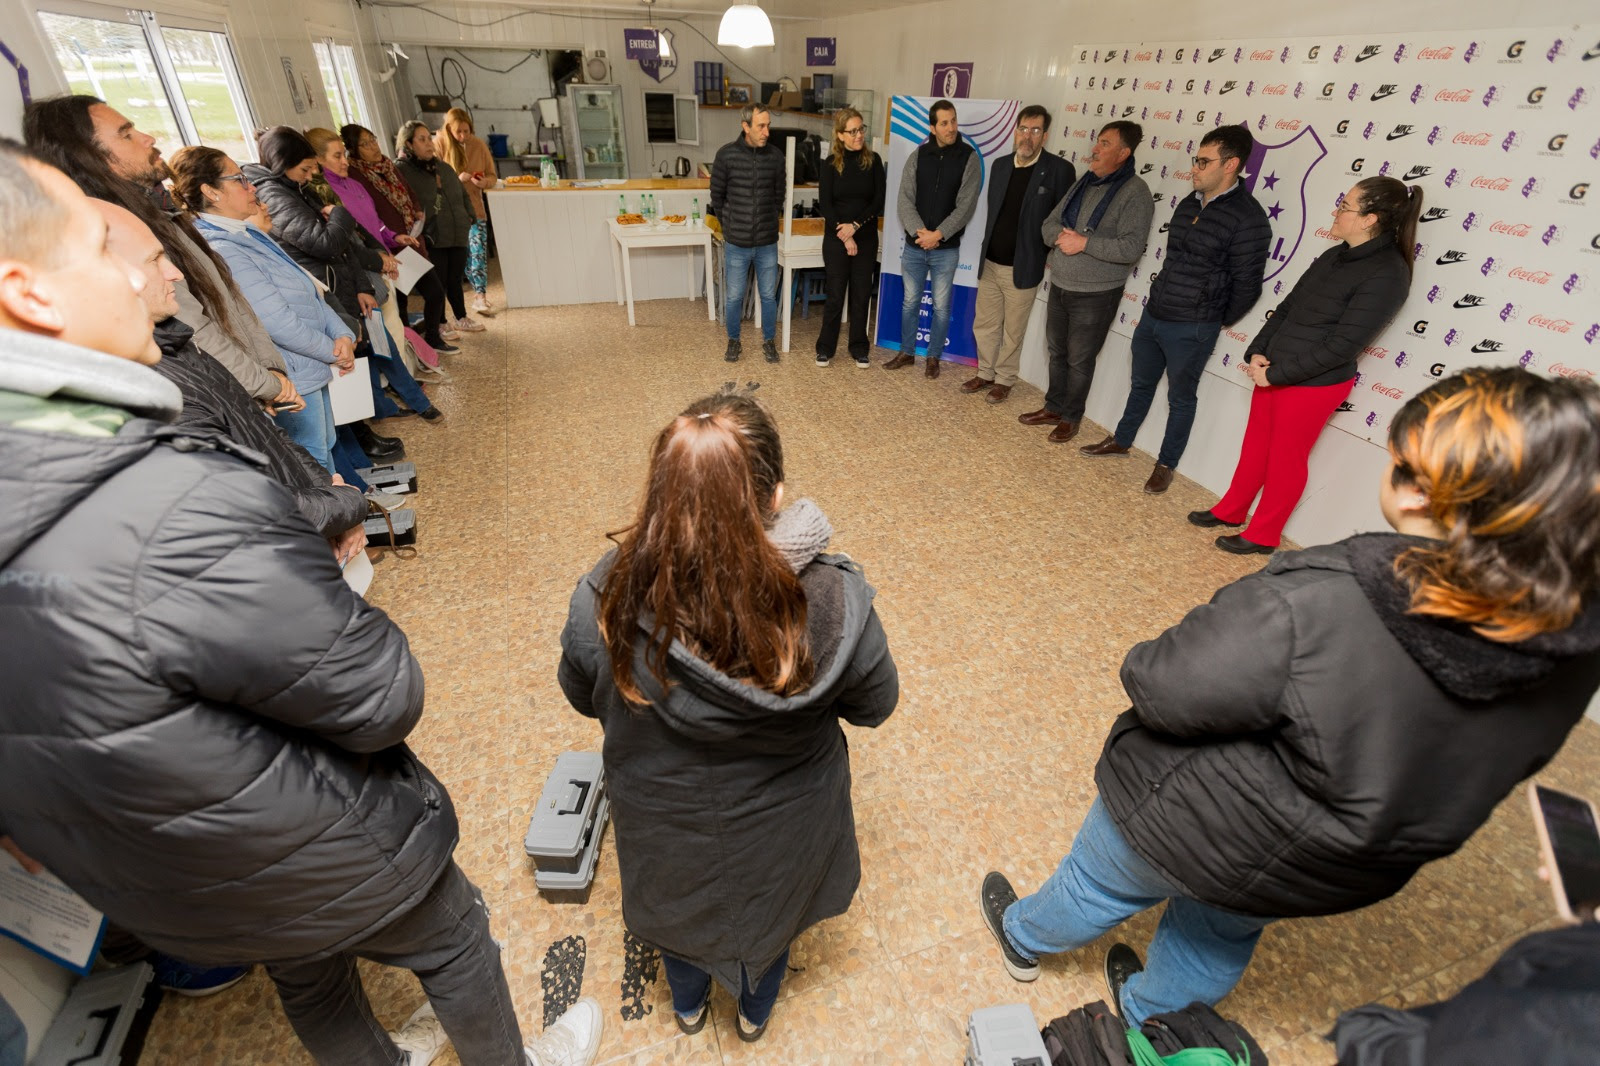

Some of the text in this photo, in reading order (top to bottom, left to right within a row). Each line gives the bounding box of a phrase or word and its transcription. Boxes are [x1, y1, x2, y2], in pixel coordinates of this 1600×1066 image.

[629, 39, 657, 49] ENTREGA
[1361, 45, 1382, 55] NIKE
[1507, 40, 1526, 59] G
[813, 46, 829, 57] CAJA
[1308, 45, 1321, 60] G
[1322, 82, 1335, 97] G
[1377, 84, 1398, 94] NIKE
[1527, 86, 1548, 105] G
[1196, 110, 1206, 123] G
[1336, 119, 1351, 134] G
[1393, 124, 1415, 134] NIKE
[1547, 134, 1569, 151] G
[1351, 158, 1365, 173] G
[1409, 165, 1432, 175] NIKE
[1569, 183, 1591, 200] G
[1425, 207, 1451, 218] NIKE
[1443, 249, 1468, 261] NIKE
[1460, 293, 1486, 305] NIKE
[1413, 319, 1429, 334] G
[1478, 338, 1504, 351] NIKE
[1429, 363, 1446, 377] G
